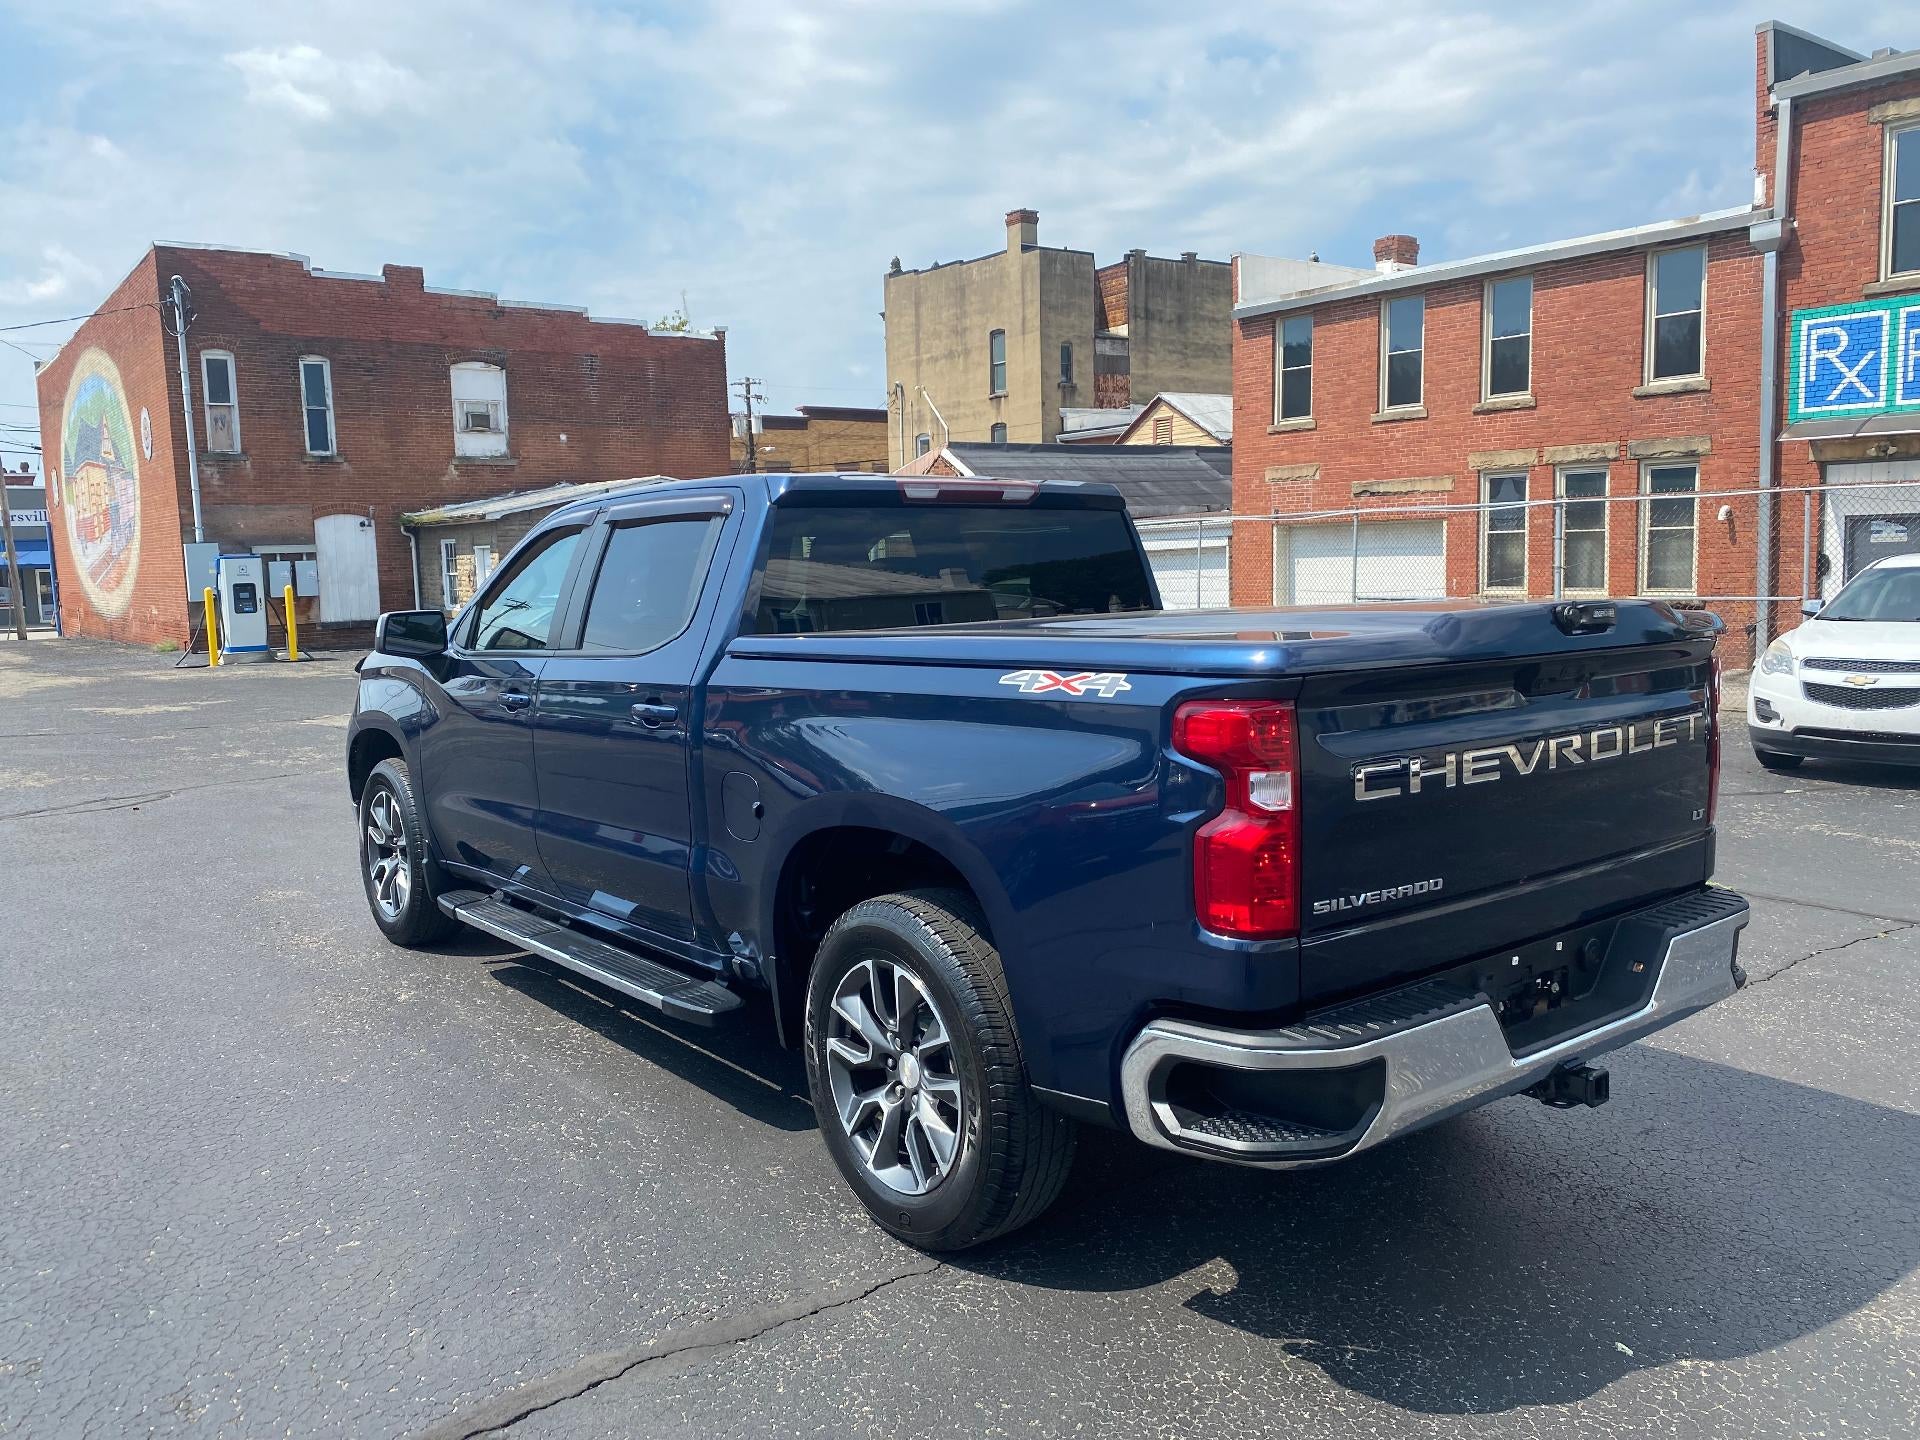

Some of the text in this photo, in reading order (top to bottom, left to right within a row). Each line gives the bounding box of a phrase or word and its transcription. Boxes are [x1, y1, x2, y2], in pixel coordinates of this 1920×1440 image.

[8, 510, 49, 522] rsvill
[1353, 711, 1703, 801] CHEVROLET
[1692, 808, 1705, 821] LT
[1312, 877, 1444, 915] SILVERADO
